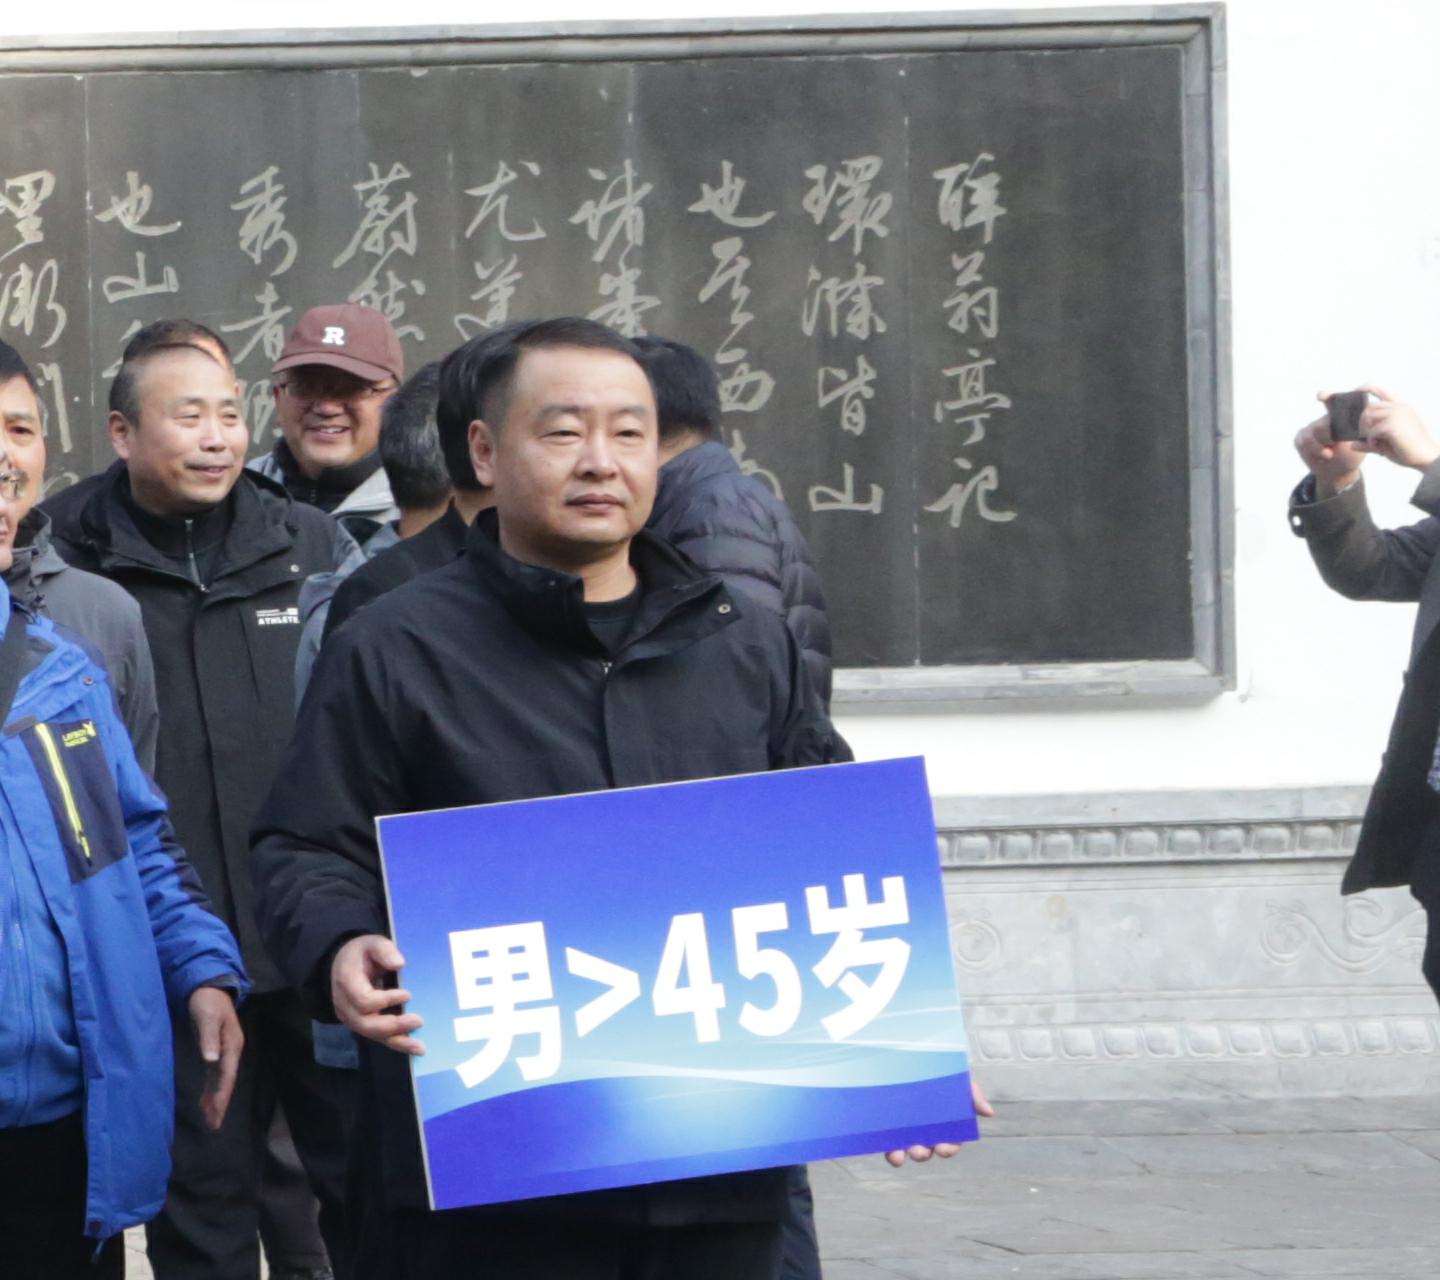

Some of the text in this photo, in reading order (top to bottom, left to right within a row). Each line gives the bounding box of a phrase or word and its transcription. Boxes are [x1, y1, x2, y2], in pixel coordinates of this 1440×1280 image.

[94, 171, 182, 378] 也山
[321, 326, 346, 346] R
[448, 873, 912, 1089] 男>45岁
